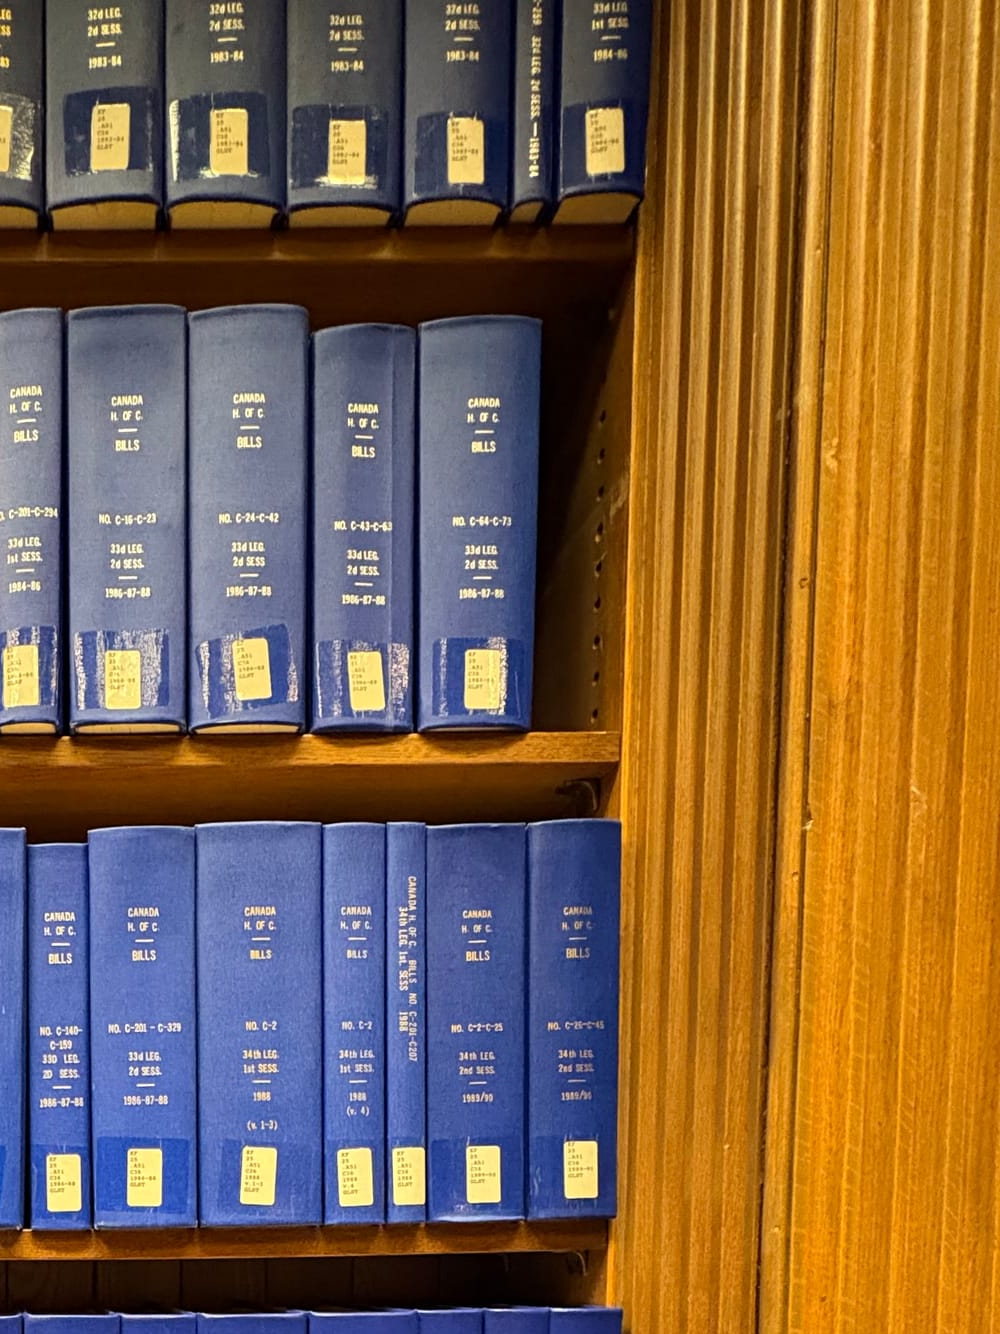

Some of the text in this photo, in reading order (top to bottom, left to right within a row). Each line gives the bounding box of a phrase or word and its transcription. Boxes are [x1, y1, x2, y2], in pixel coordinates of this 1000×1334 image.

[112, 395, 143, 406] CANADA
[123, 411, 132, 421] OF
[115, 440, 139, 451] BILLS
[99, 514, 111, 524] NO.
[111, 544, 125, 554] 33d
[111, 559, 121, 569] 2d
[408, 876, 418, 911] CANADA
[244, 907, 276, 916] CANADA
[256, 921, 265, 930] OF
[409, 927, 418, 938] OF
[250, 950, 271, 959] BILLS
[408, 960, 418, 984] BILLS
[246, 1021, 277, 1031] NO. C-2
[243, 1050, 261, 1059] 34th
[244, 1064, 255, 1073] 1st
[253, 1092, 271, 1101] 1988
